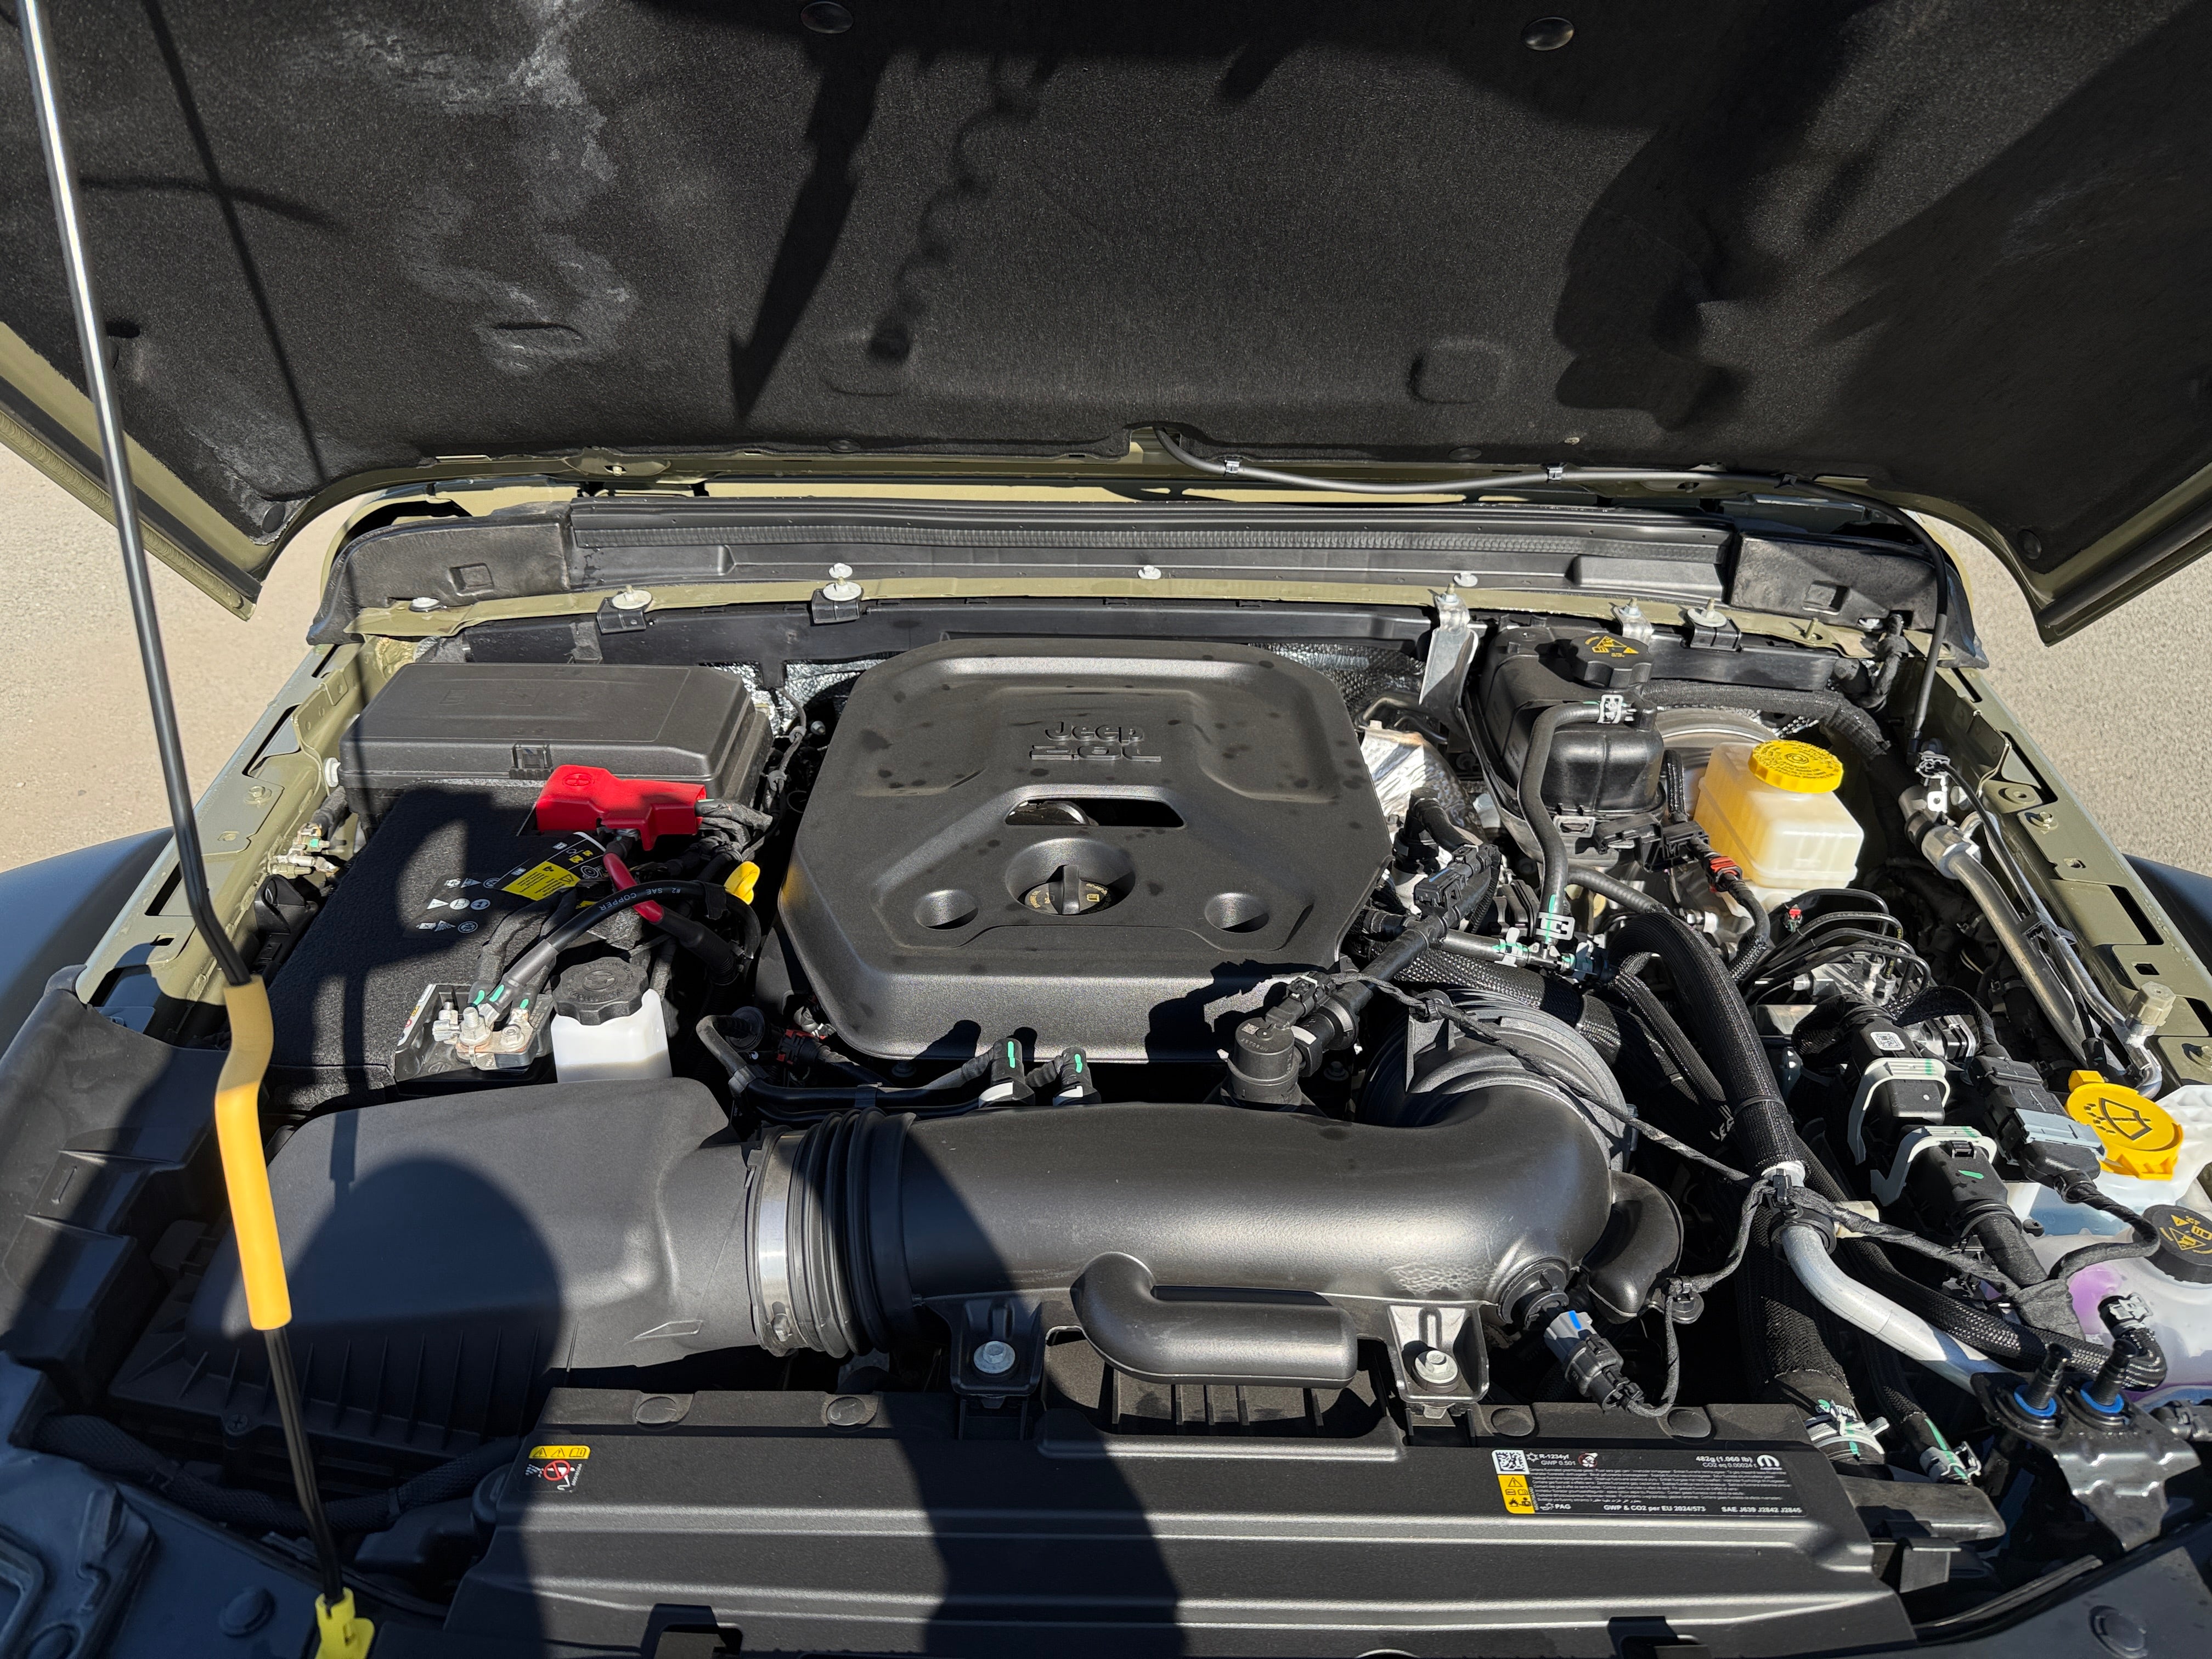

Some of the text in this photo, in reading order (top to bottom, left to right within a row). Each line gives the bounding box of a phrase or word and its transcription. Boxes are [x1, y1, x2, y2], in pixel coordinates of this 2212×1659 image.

[1045, 721, 1144, 745] Jeep
[1029, 744, 1161, 763] 2.0L
[598, 892, 637, 911] COPPER
[1029, 895, 1041, 909] ENGINE
